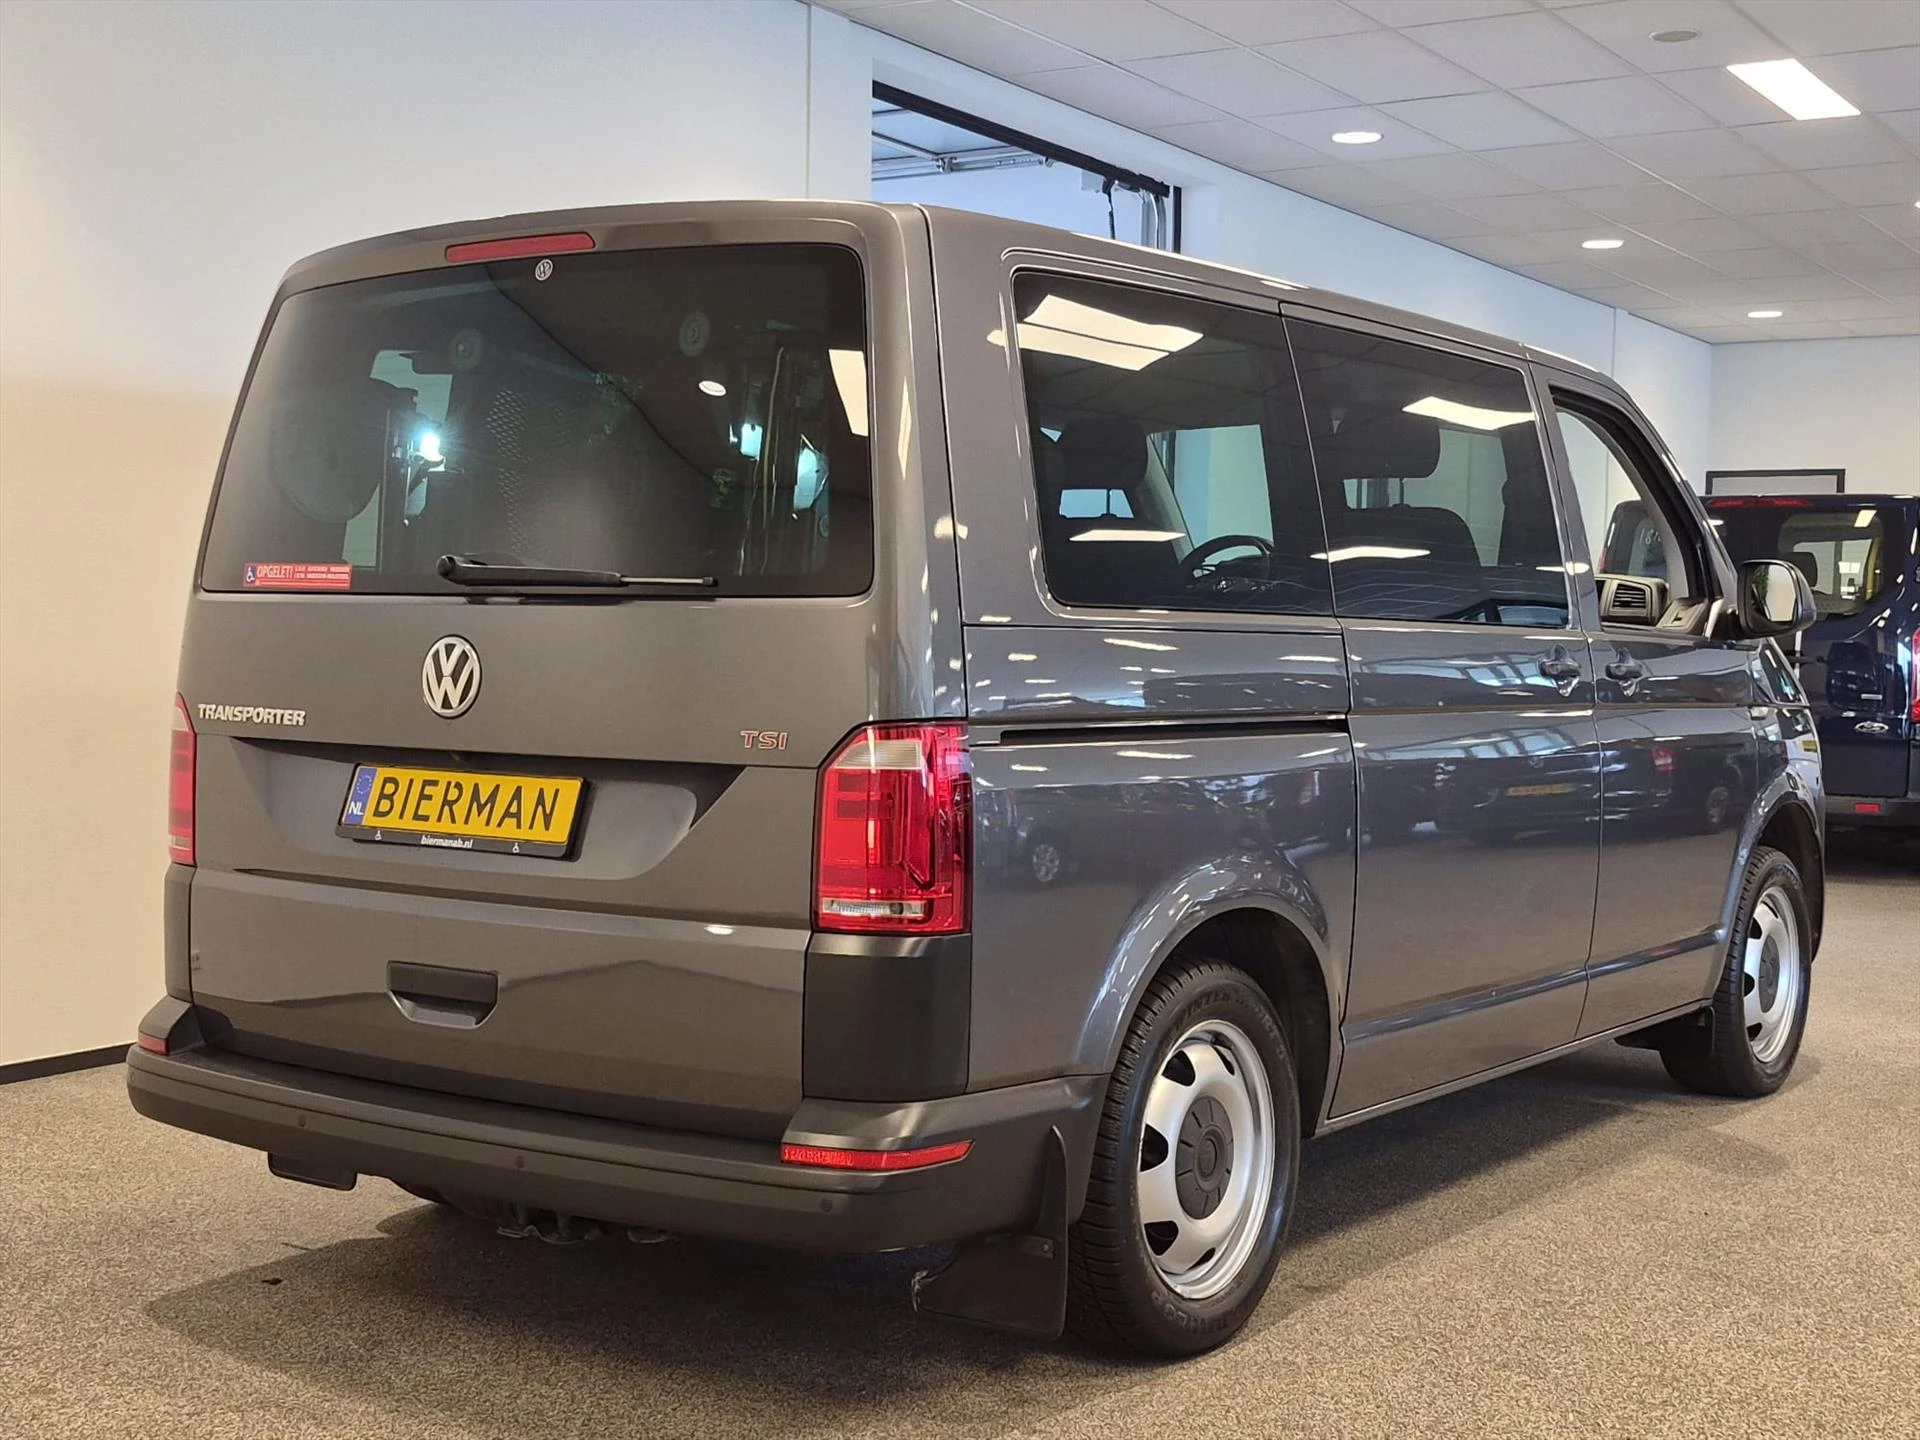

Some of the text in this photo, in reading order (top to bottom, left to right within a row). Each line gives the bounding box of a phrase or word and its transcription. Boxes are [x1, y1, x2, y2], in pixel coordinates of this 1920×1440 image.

[198, 703, 306, 726] TRANSPORTER
[740, 730, 788, 750] TSI
[349, 800, 364, 816] NL
[372, 776, 560, 832] BIERMAN
[420, 834, 474, 849] biermanab.nl
